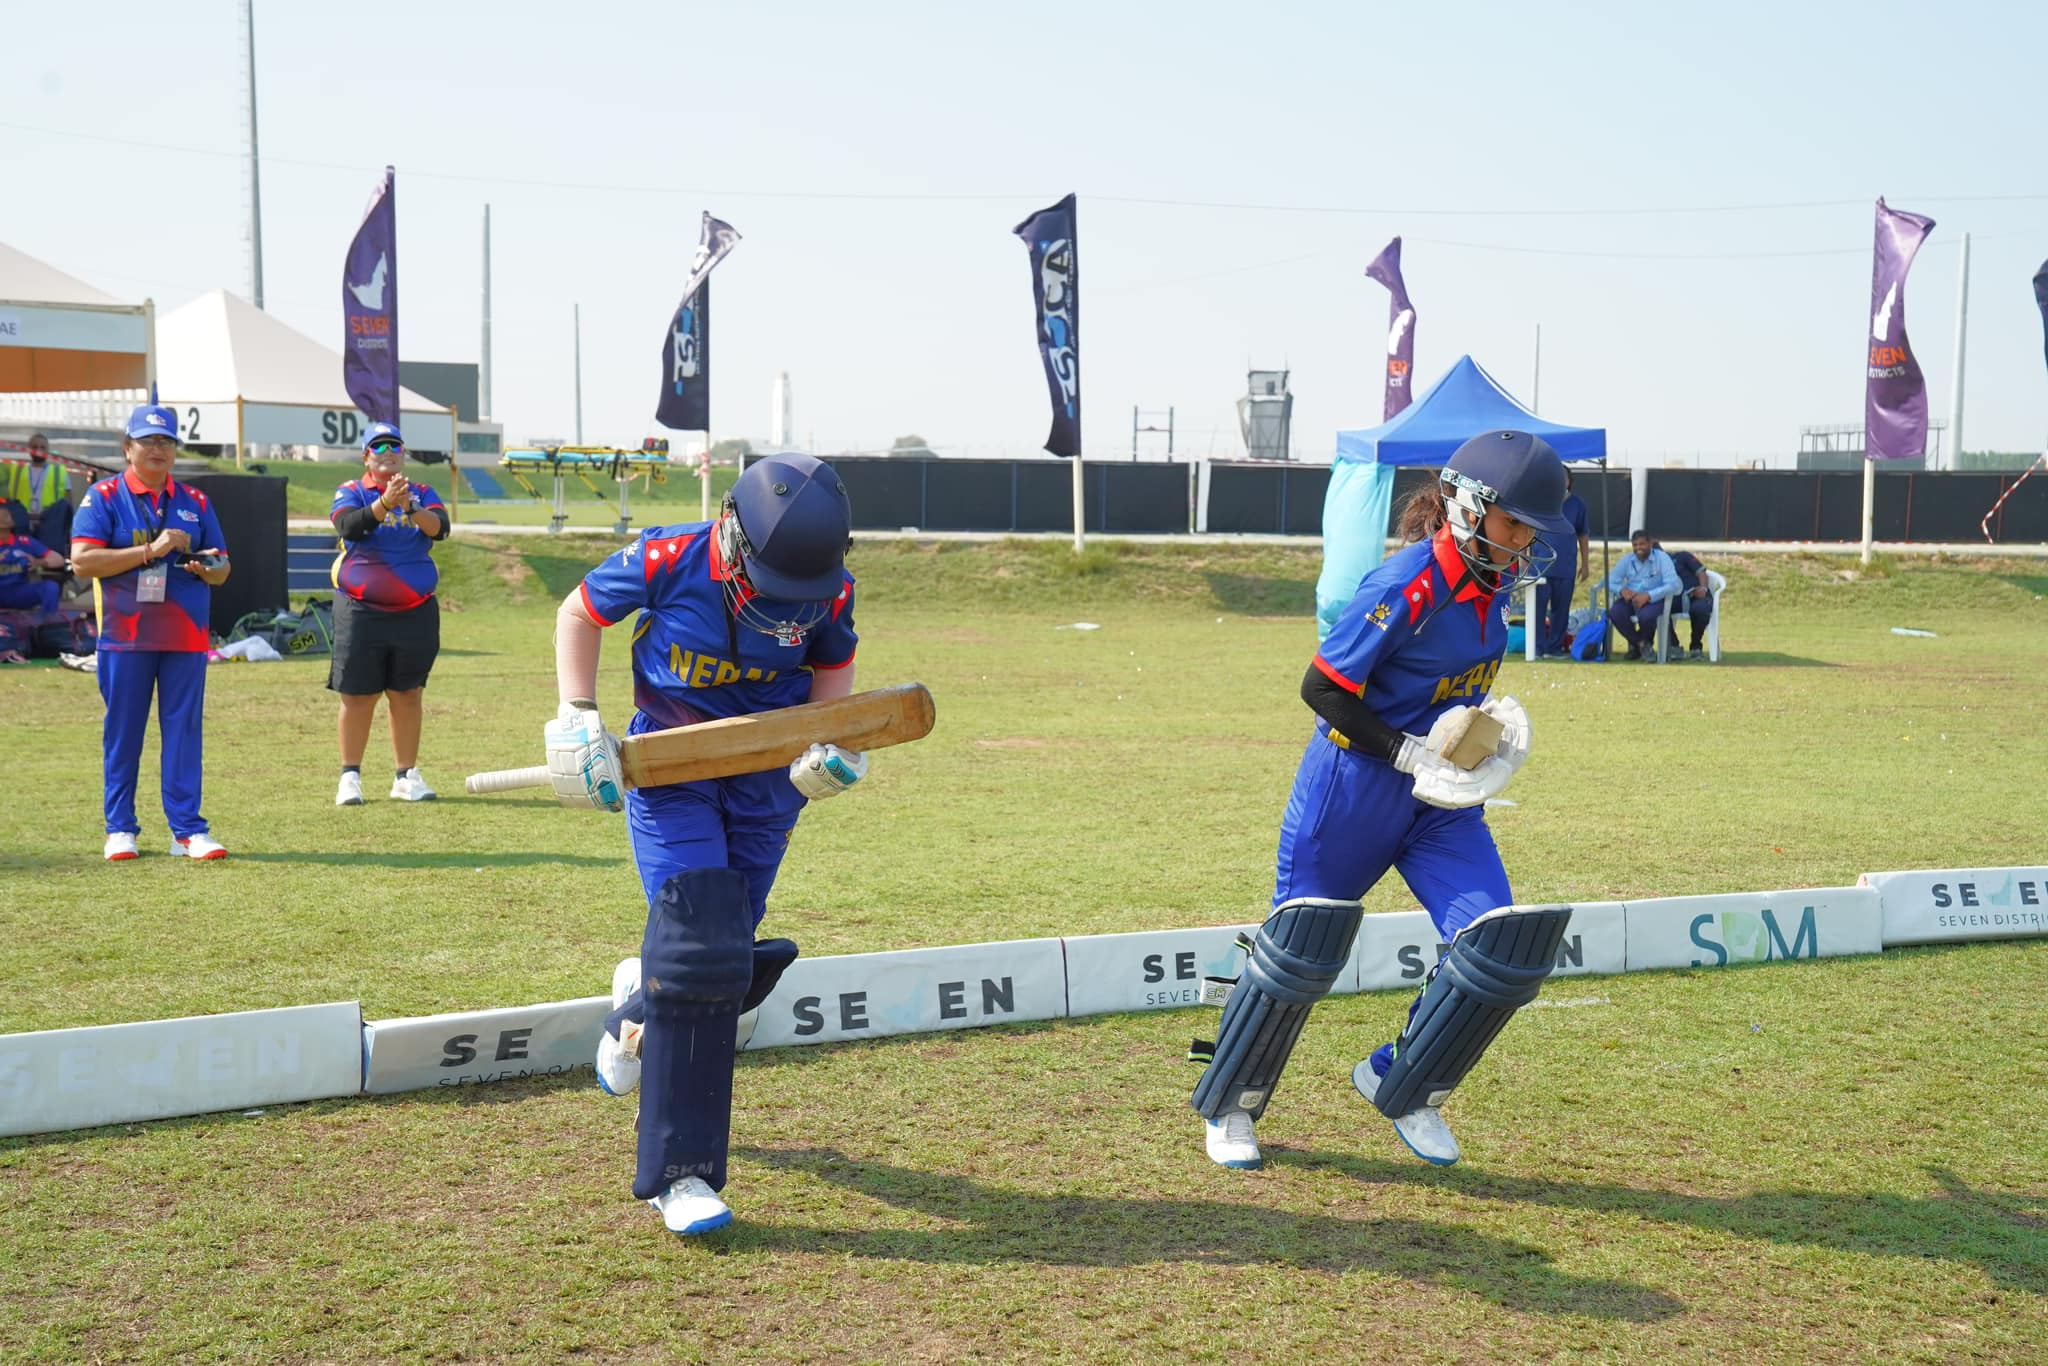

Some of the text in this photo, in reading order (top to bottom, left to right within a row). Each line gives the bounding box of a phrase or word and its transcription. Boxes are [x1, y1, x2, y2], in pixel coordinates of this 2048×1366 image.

[322, 410, 368, 445] SD-
[2018, 881, 2048, 905] E
[1939, 912, 2048, 927] SEVEN DISTRI
[1690, 906, 1818, 967] SDM
